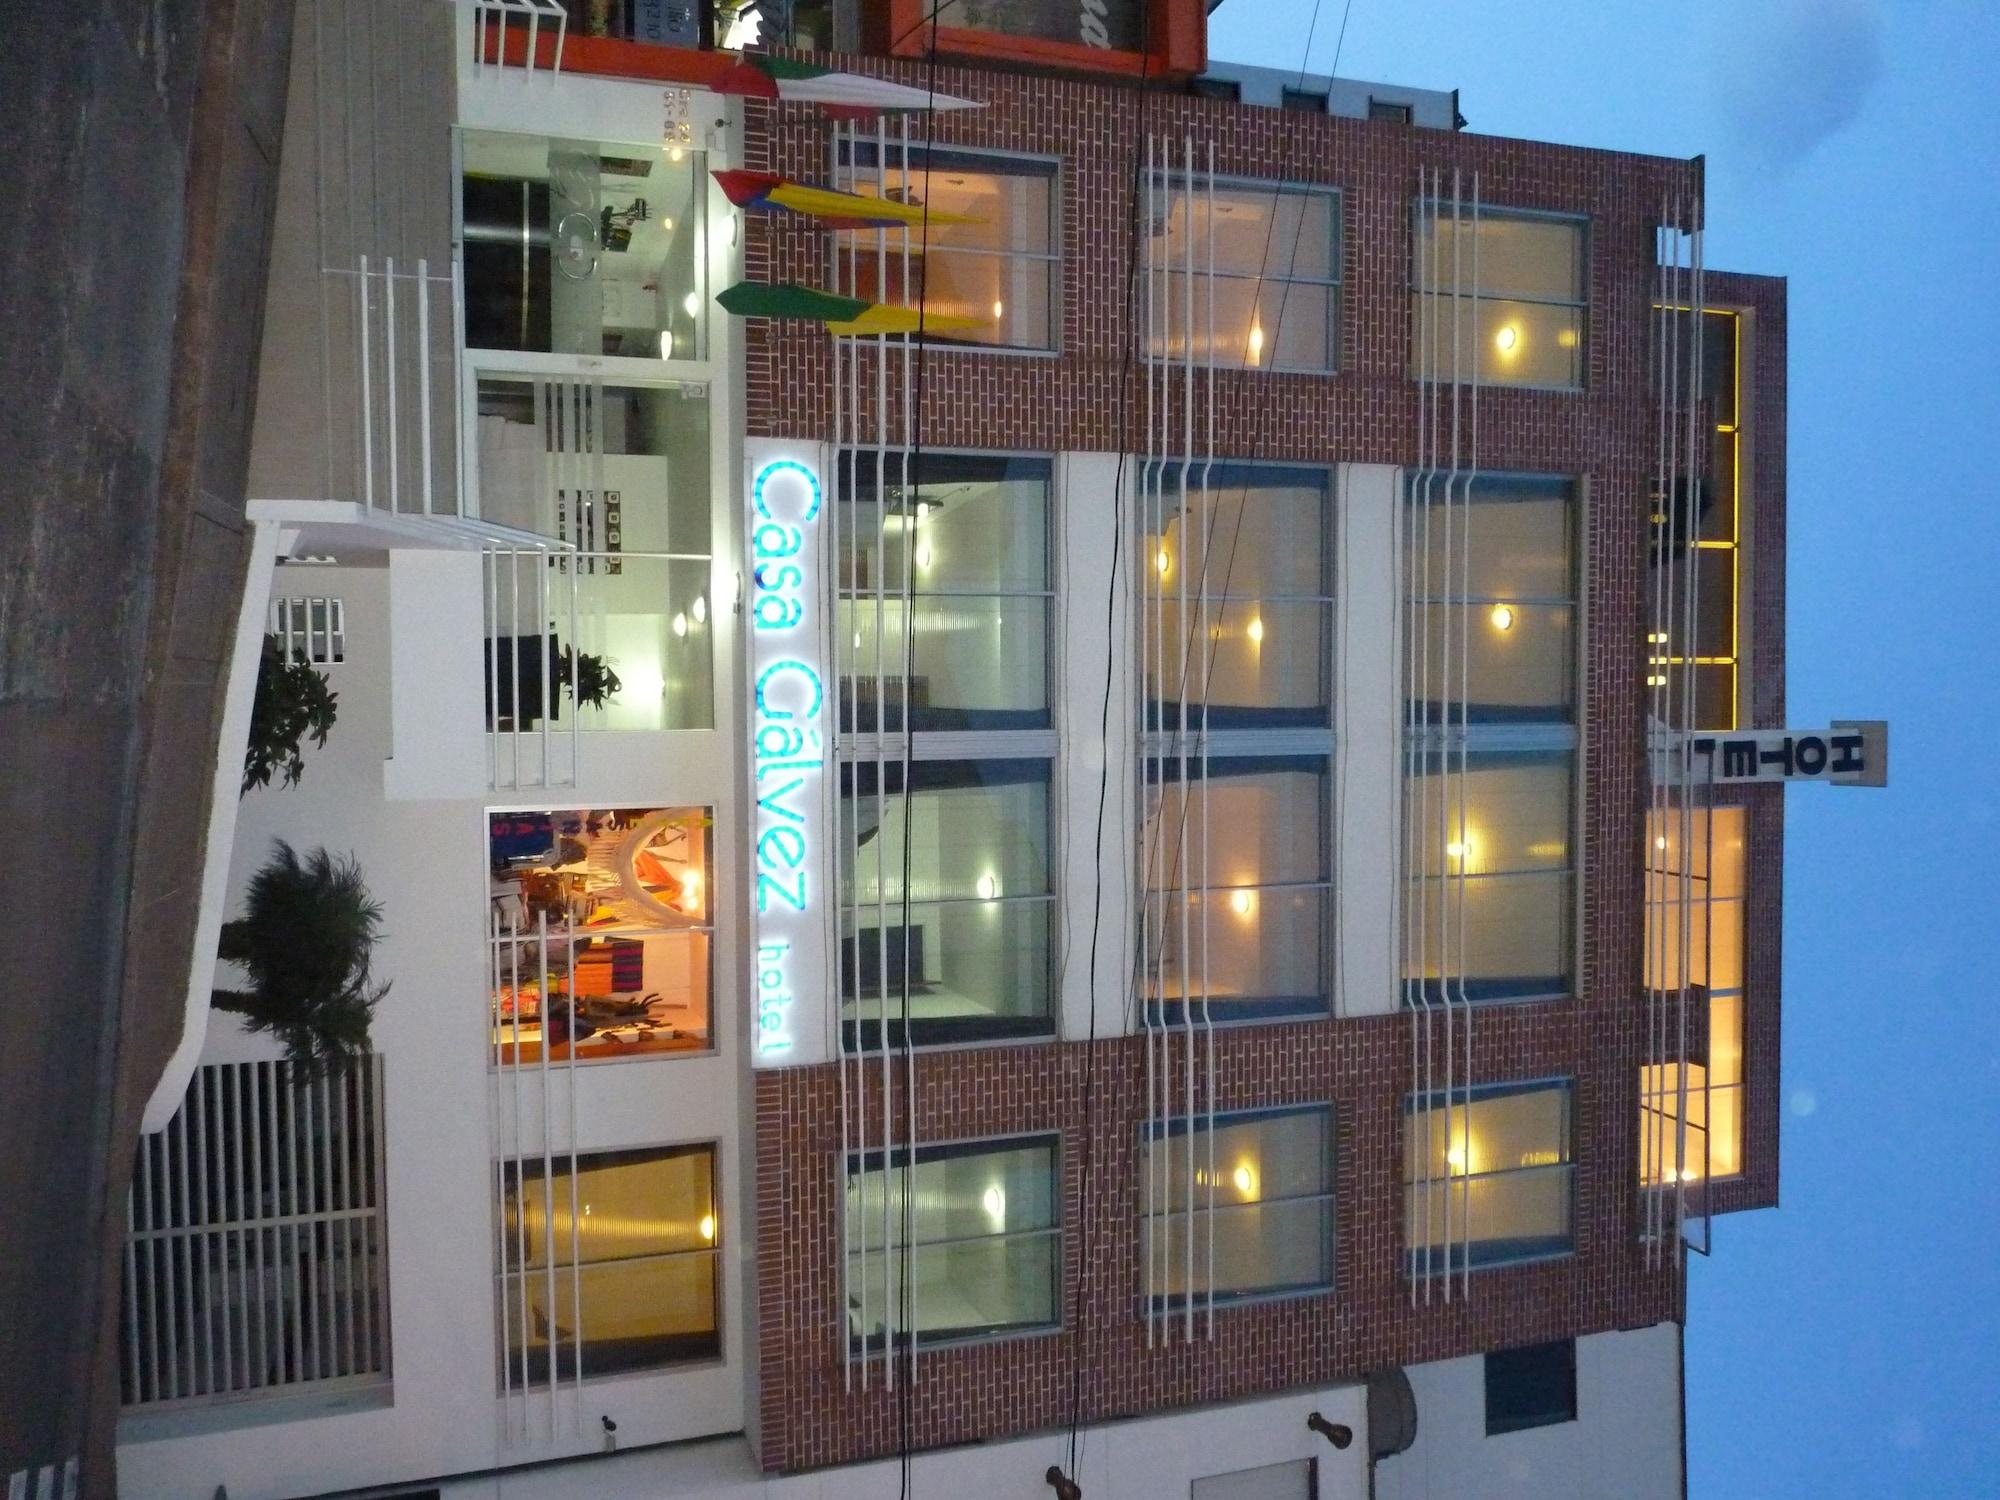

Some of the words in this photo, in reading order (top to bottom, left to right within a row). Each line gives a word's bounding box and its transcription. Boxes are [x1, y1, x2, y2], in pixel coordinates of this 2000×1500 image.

[754, 460, 822, 630] Casa
[755, 659, 824, 912] Gálvez
[1687, 736, 1864, 777] HOTEL
[758, 944, 793, 1054] hotel
